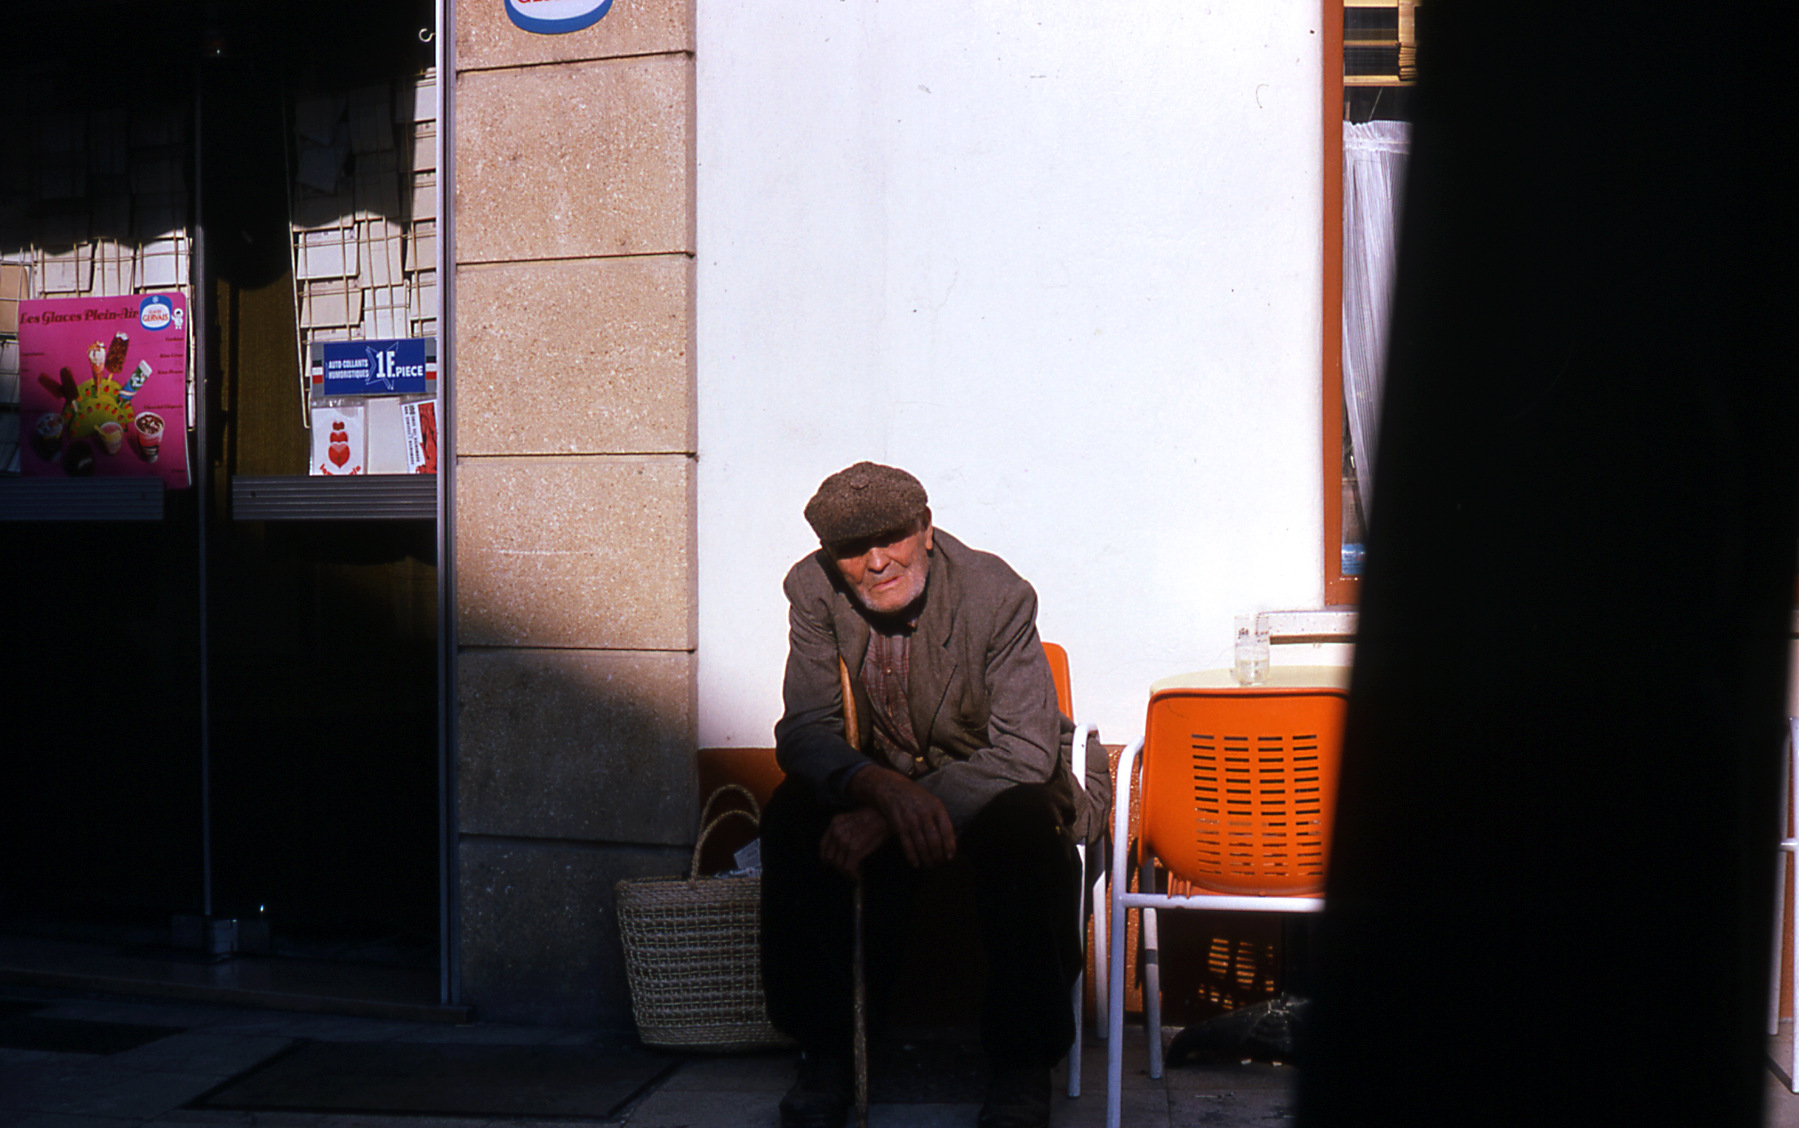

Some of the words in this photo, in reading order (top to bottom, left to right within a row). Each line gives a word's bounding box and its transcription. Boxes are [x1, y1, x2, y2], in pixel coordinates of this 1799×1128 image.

[20, 312, 40, 325] Les
[42, 310, 82, 326] Glaces
[84, 307, 139, 321] Plein-Air
[142, 313, 169, 322] GERVAIS
[395, 365, 423, 377] PIECE
